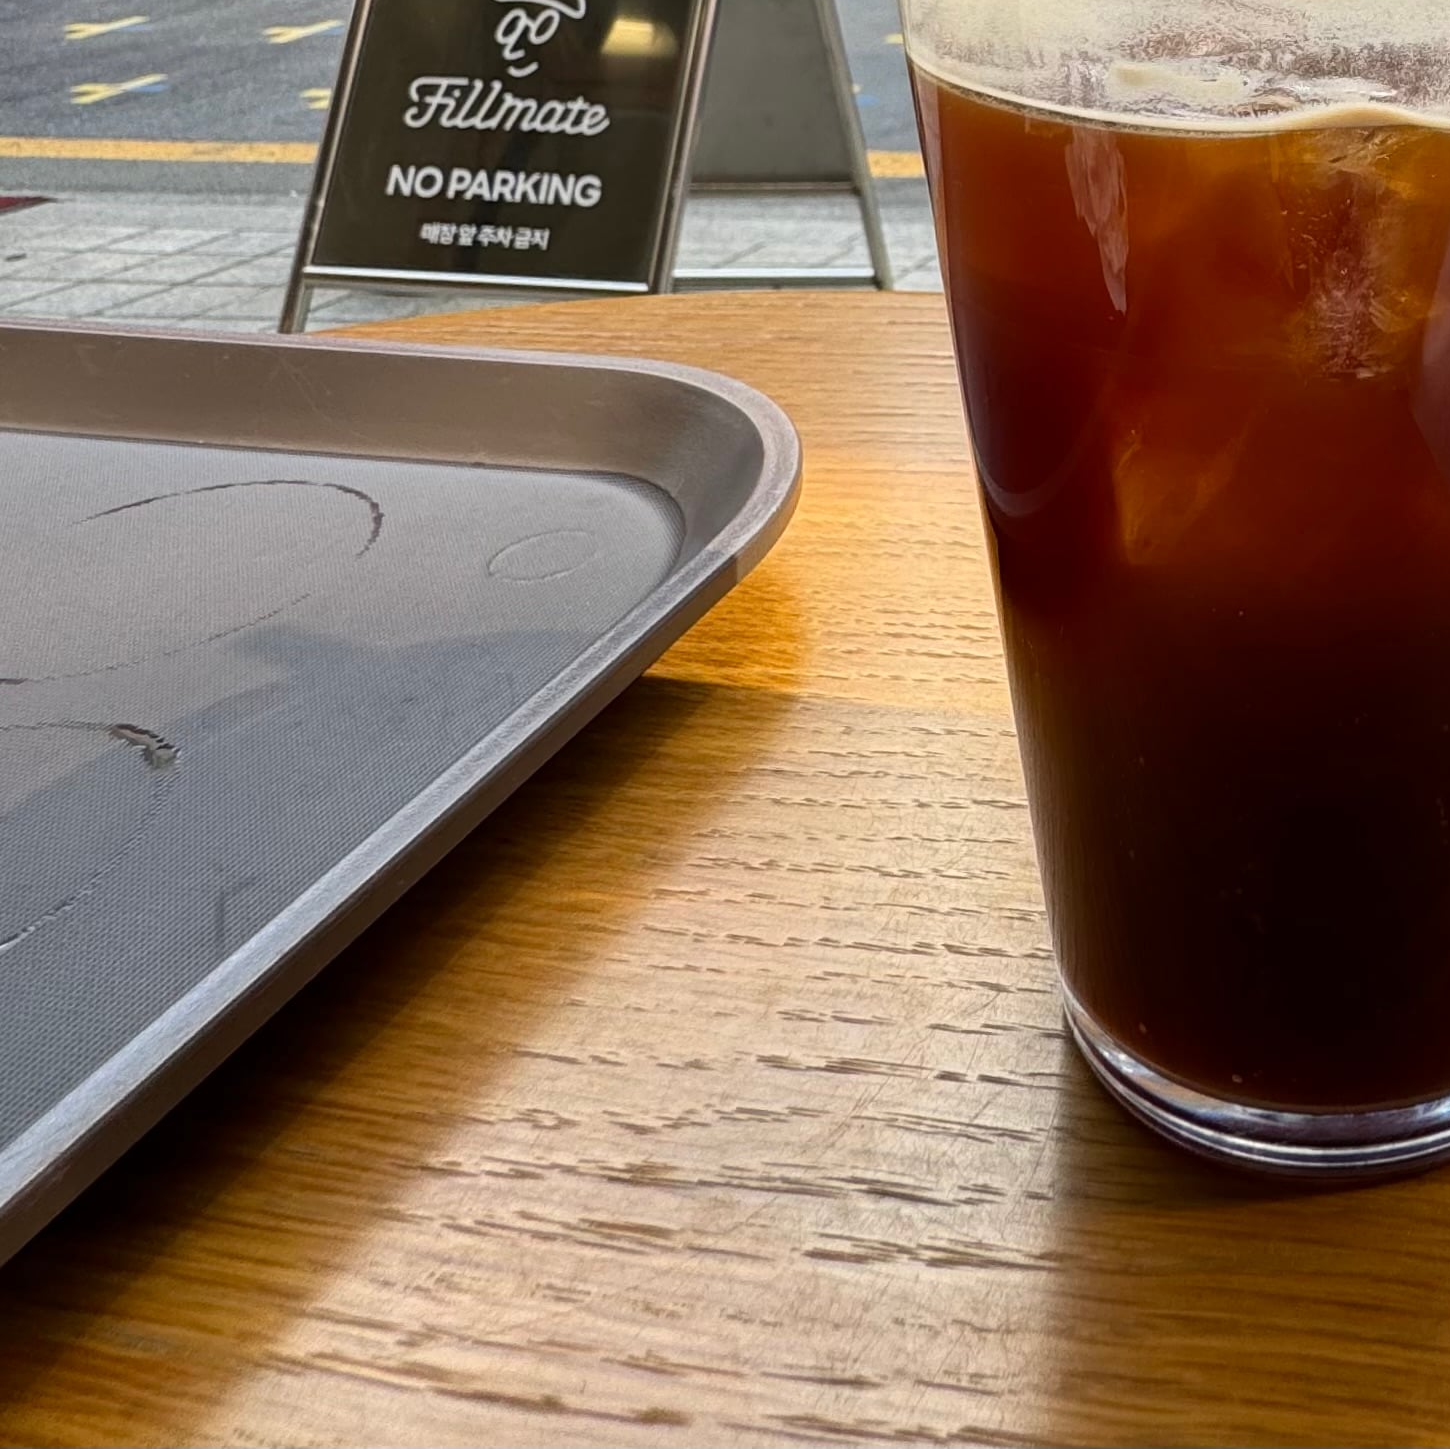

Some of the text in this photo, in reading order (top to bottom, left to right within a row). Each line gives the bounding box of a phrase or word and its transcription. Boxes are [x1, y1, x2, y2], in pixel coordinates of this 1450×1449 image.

[403, 75, 611, 136] Fillmate
[385, 164, 603, 208] NO PARKING
[420, 221, 550, 251] 매장 앞 주차 금지
